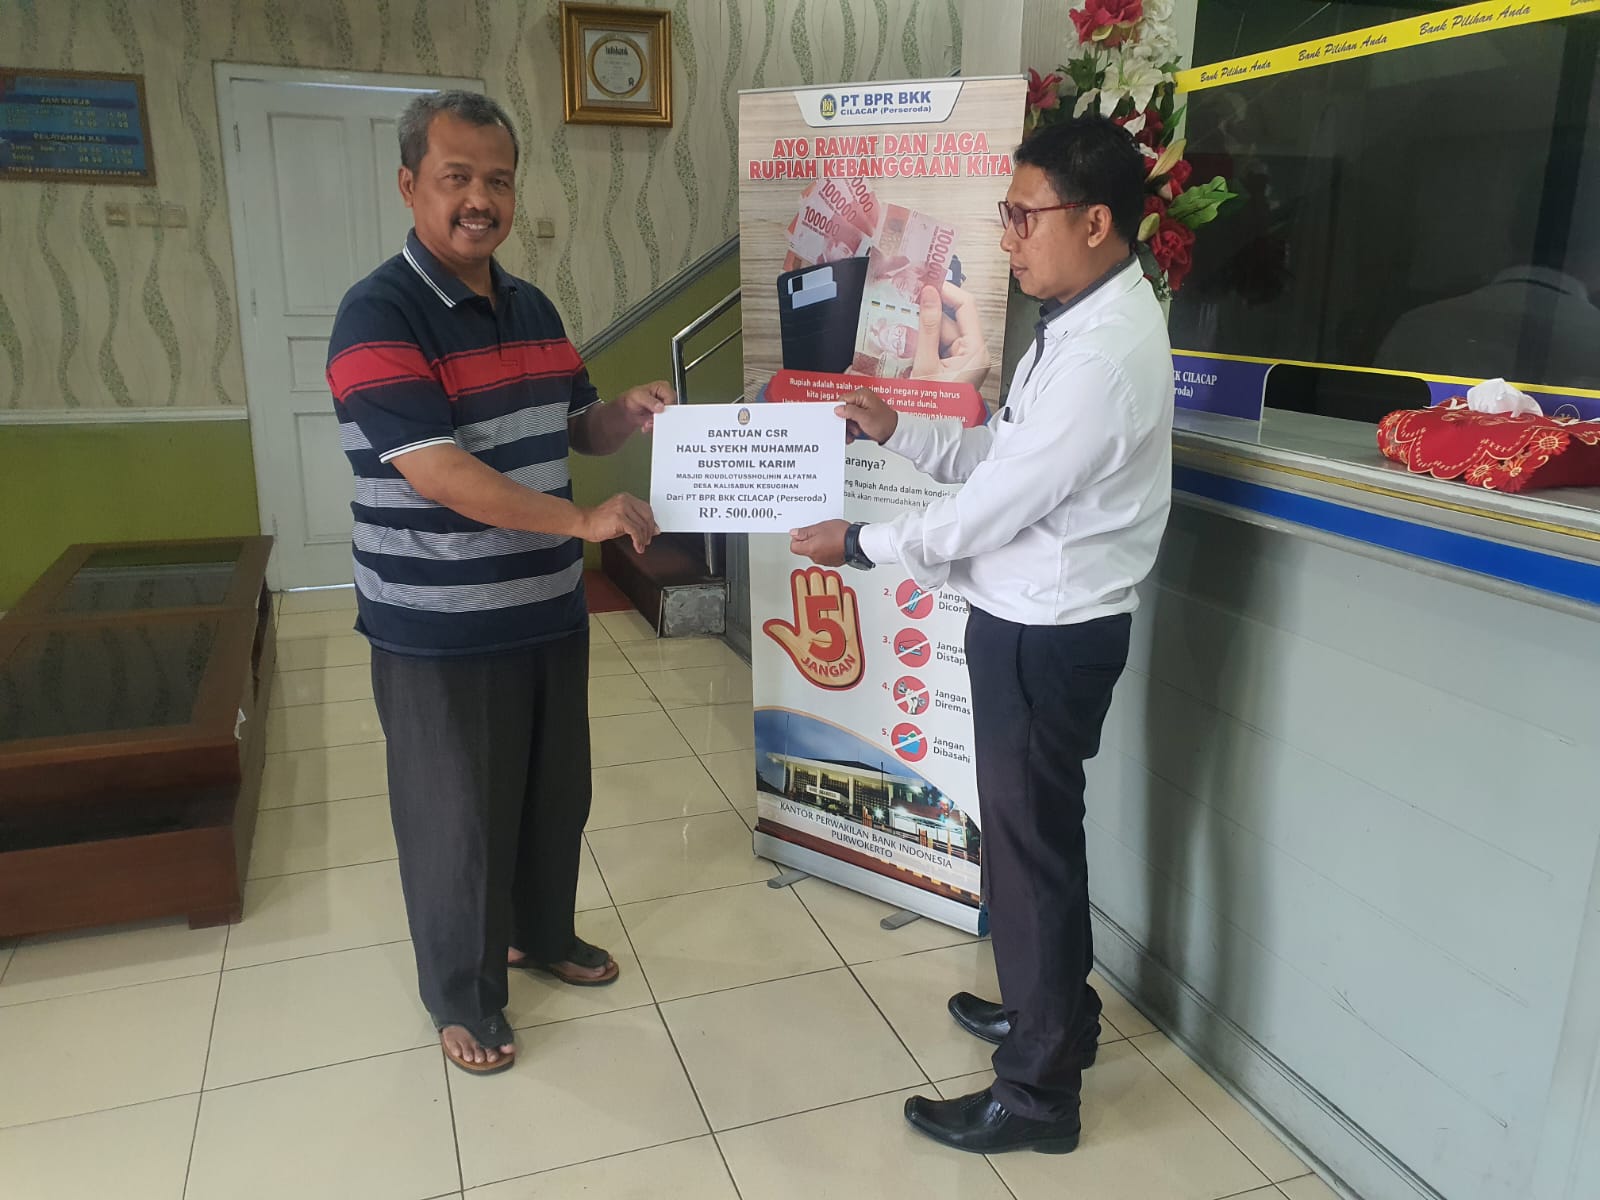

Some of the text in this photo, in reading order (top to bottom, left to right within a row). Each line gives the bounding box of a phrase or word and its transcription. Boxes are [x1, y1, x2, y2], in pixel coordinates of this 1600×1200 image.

[1420, 5, 1531, 36] Bank Pilihan Anda
[1298, 35, 1387, 62] Bank Pilihan Anda
[1200, 60, 1272, 82] Bank Pilihan Anda
[841, 91, 931, 107] PT BPR BKK
[881, 106, 931, 114] (Perseroda)
[772, 131, 989, 158] AYO RAWAT DAN JAGA
[749, 154, 1013, 179] RUPIAH KEBANGGAAN KITA
[822, 178, 857, 222] 100000
[851, 177, 873, 213] 0000
[804, 206, 840, 236] 100000
[1183, 371, 1218, 385] CILACAP
[789, 378, 811, 387] Rupiah
[812, 380, 834, 389] adalah
[836, 381, 852, 390] salah
[893, 388, 918, 396] negara
[920, 390, 937, 399] yang
[939, 389, 960, 399] harus
[806, 390, 818, 398] kita
[820, 391, 834, 400] jaga
[896, 399, 915, 407] mata
[917, 399, 938, 409] dunia.
[708, 429, 788, 438] BANTUAN CSR
[676, 444, 819, 453] HAUL SYEKH MUHAMMAD
[698, 460, 796, 468] BUSTOMIL KARIM
[845, 456, 886, 471] aranya?
[855, 480, 876, 489] Rupiah
[879, 483, 898, 492] Anda
[900, 485, 922, 495] dalam
[718, 494, 735, 502] BKK
[737, 494, 774, 502] CILACAP
[776, 494, 827, 503] (Perseroda)
[857, 492, 871, 501] akan
[874, 496, 921, 507] memudahkan
[699, 507, 782, 520] RP. 500.000,-
[883, 588, 967, 603] 2. Janga
[939, 602, 968, 614] Dicore
[804, 595, 846, 662] 5
[882, 635, 965, 654] 3. Janga
[801, 654, 856, 677] JANGAN
[937, 652, 967, 666] Distap
[882, 682, 967, 704] 4. Jangan
[935, 699, 970, 715] Diremas
[882, 728, 965, 751] 5. Jangan
[933, 746, 971, 763] Dibasahi
[780, 801, 952, 869] KANTOR PERWAKILAN BANK INDONESIA
[832, 831, 893, 858] PURWOKERTO
